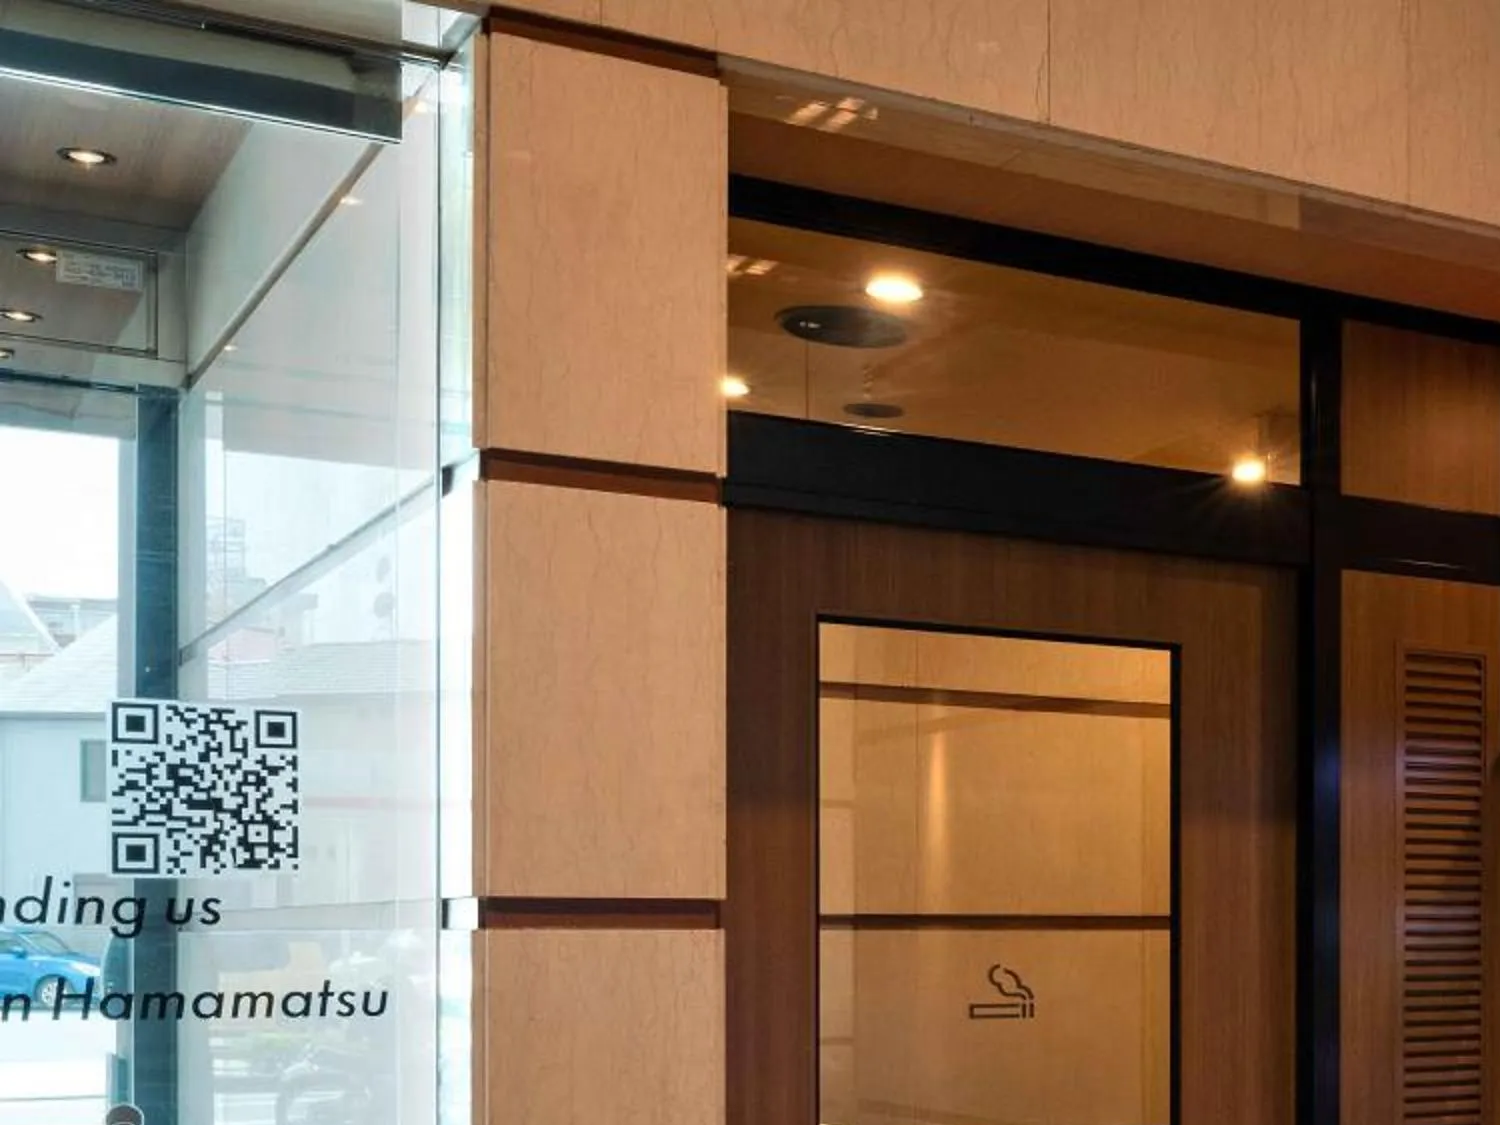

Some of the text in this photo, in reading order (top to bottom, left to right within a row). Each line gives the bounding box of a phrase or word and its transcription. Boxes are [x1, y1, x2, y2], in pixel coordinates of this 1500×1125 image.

[0, 875, 222, 939] ding us
[51, 976, 389, 1021] Hamamatsu
